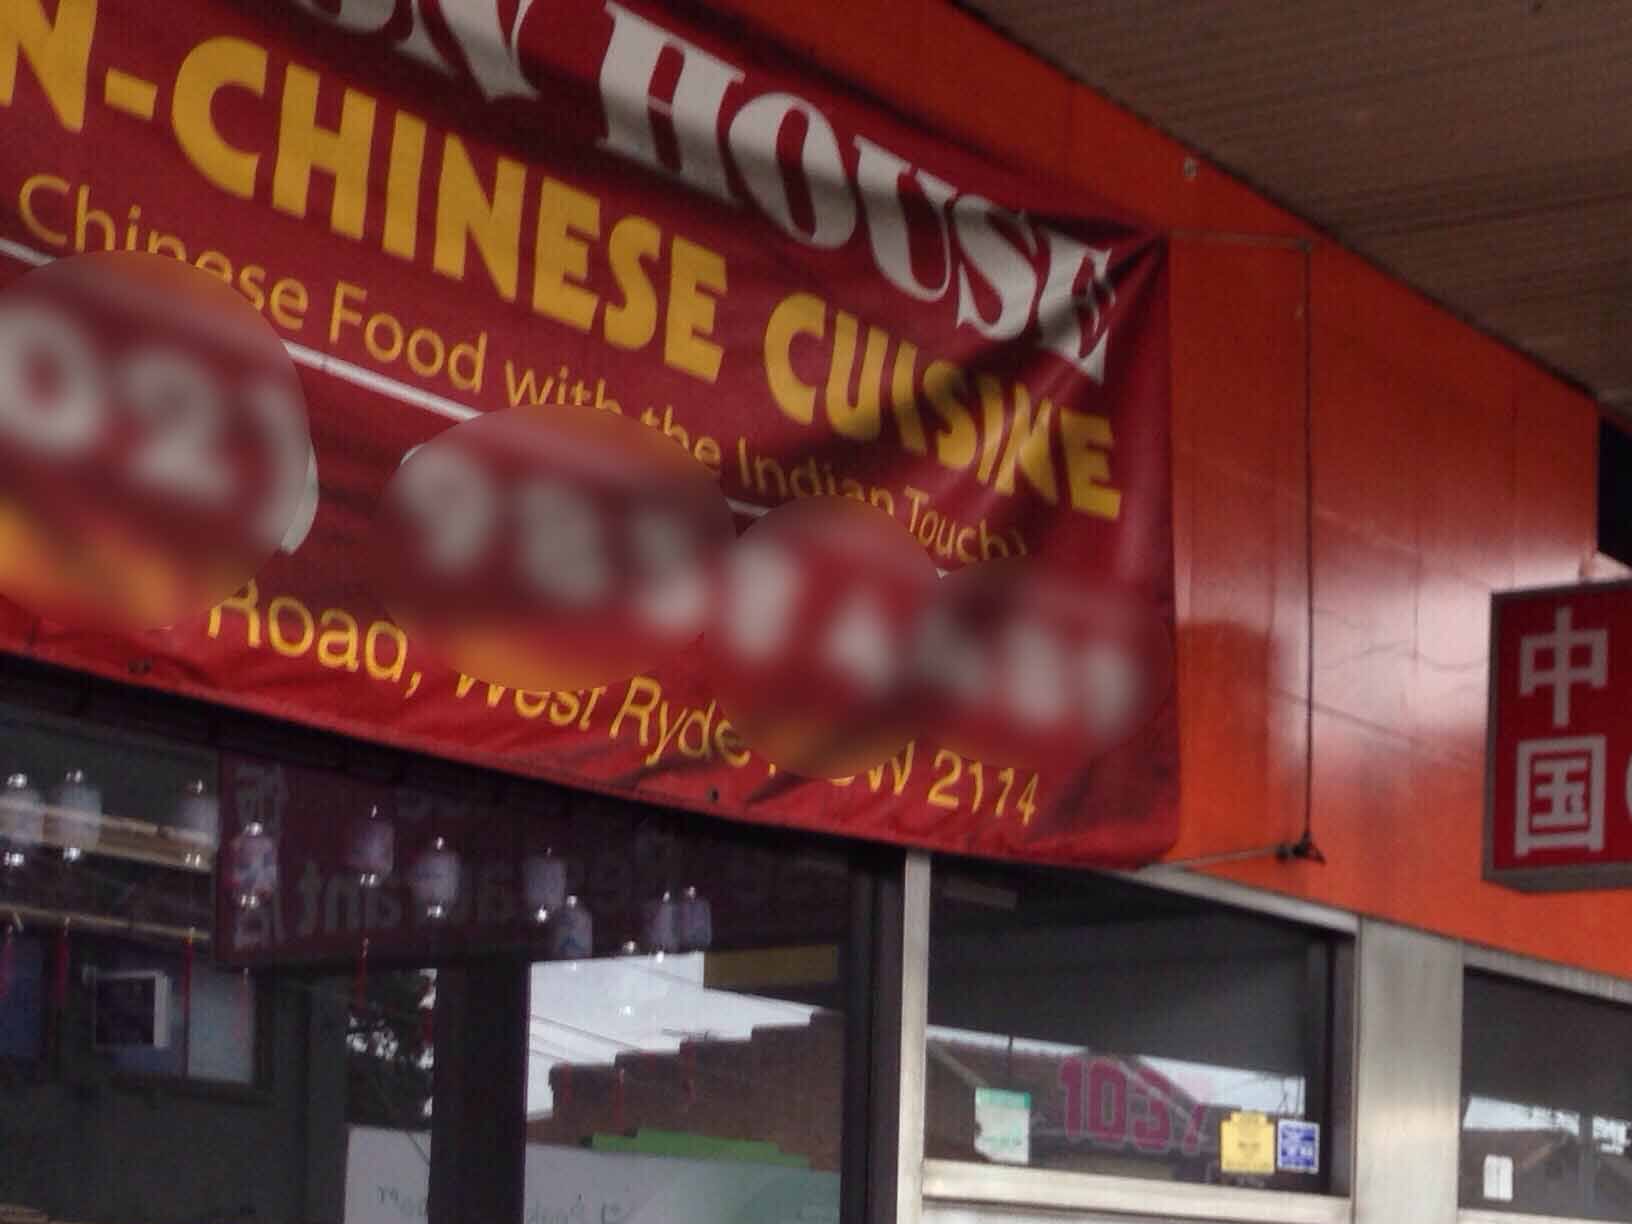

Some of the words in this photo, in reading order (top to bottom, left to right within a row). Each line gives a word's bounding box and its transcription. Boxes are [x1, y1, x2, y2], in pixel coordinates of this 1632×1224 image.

[596, 3, 1116, 386] HOUSE
[328, 279, 488, 394] Food
[762, 291, 1122, 521] CUISINE
[1514, 606, 1609, 857] 中国
